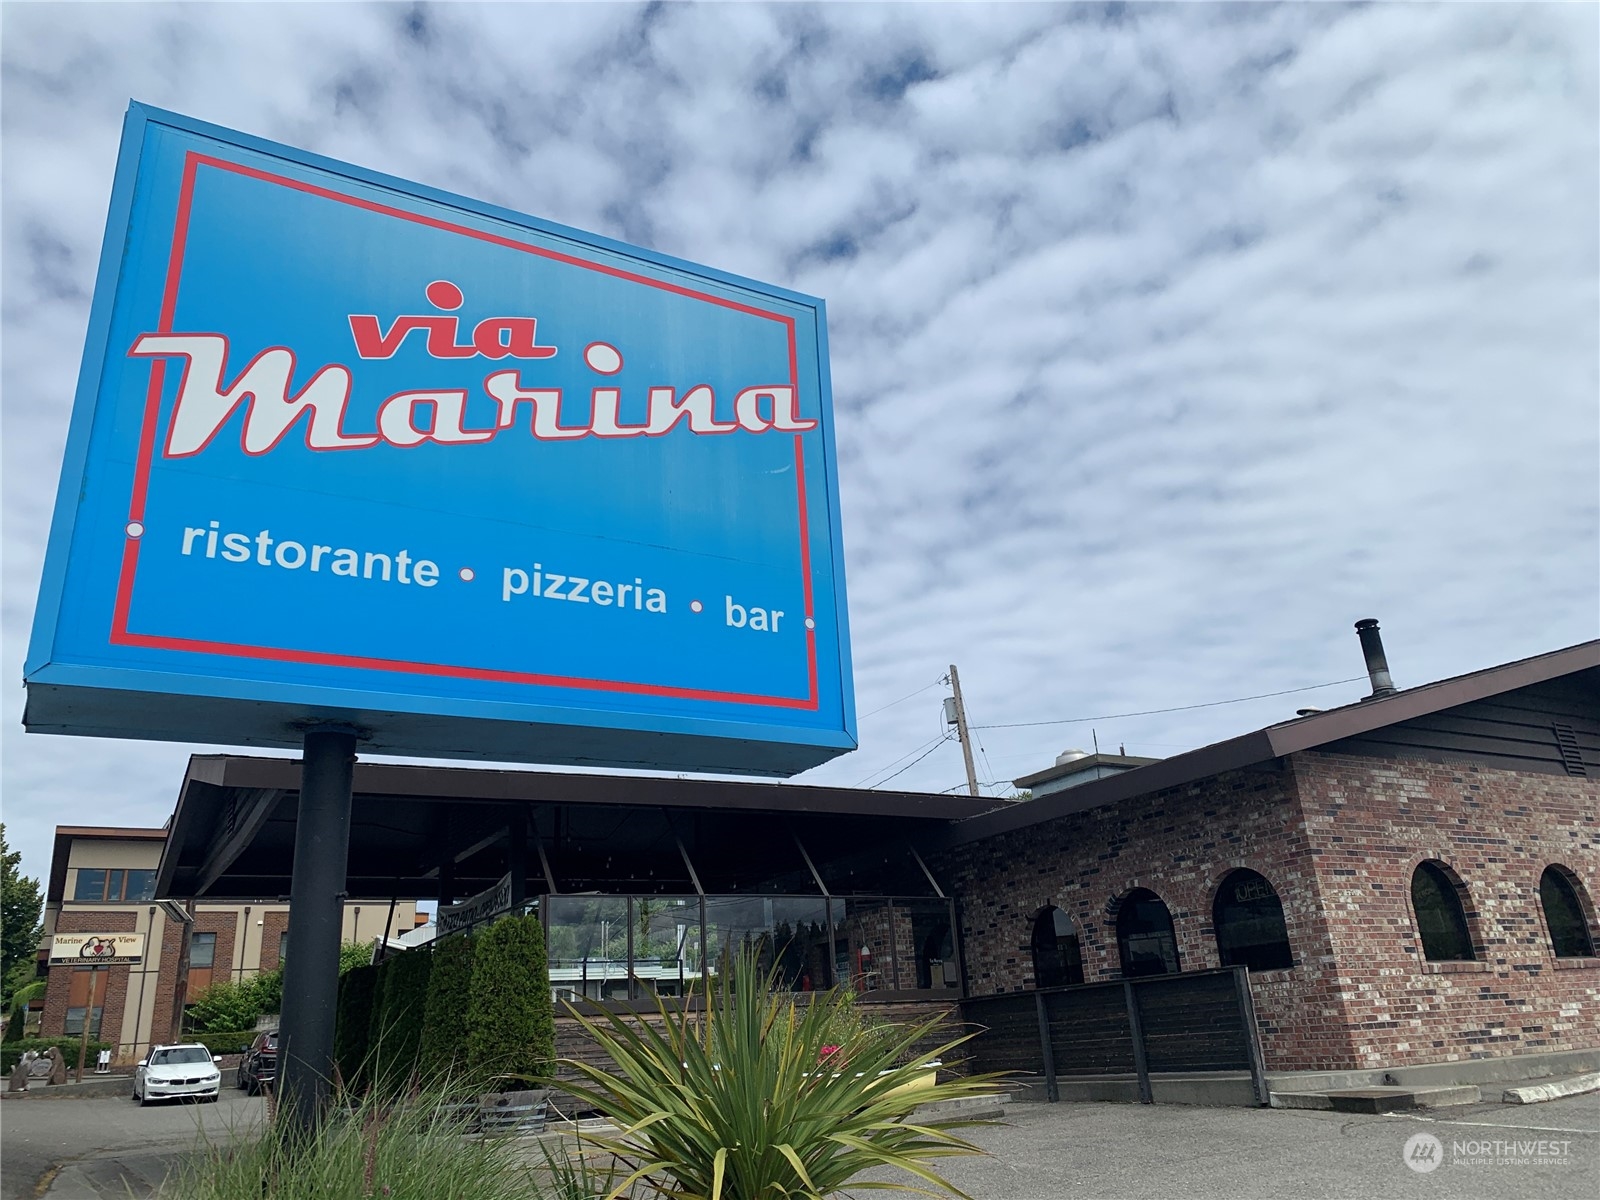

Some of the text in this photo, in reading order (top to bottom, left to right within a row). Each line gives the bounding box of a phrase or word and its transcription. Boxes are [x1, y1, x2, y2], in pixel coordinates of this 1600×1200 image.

[348, 280, 558, 360] via
[127, 332, 818, 458] Marina
[181, 520, 785, 633] ristorante pizzeria bar
